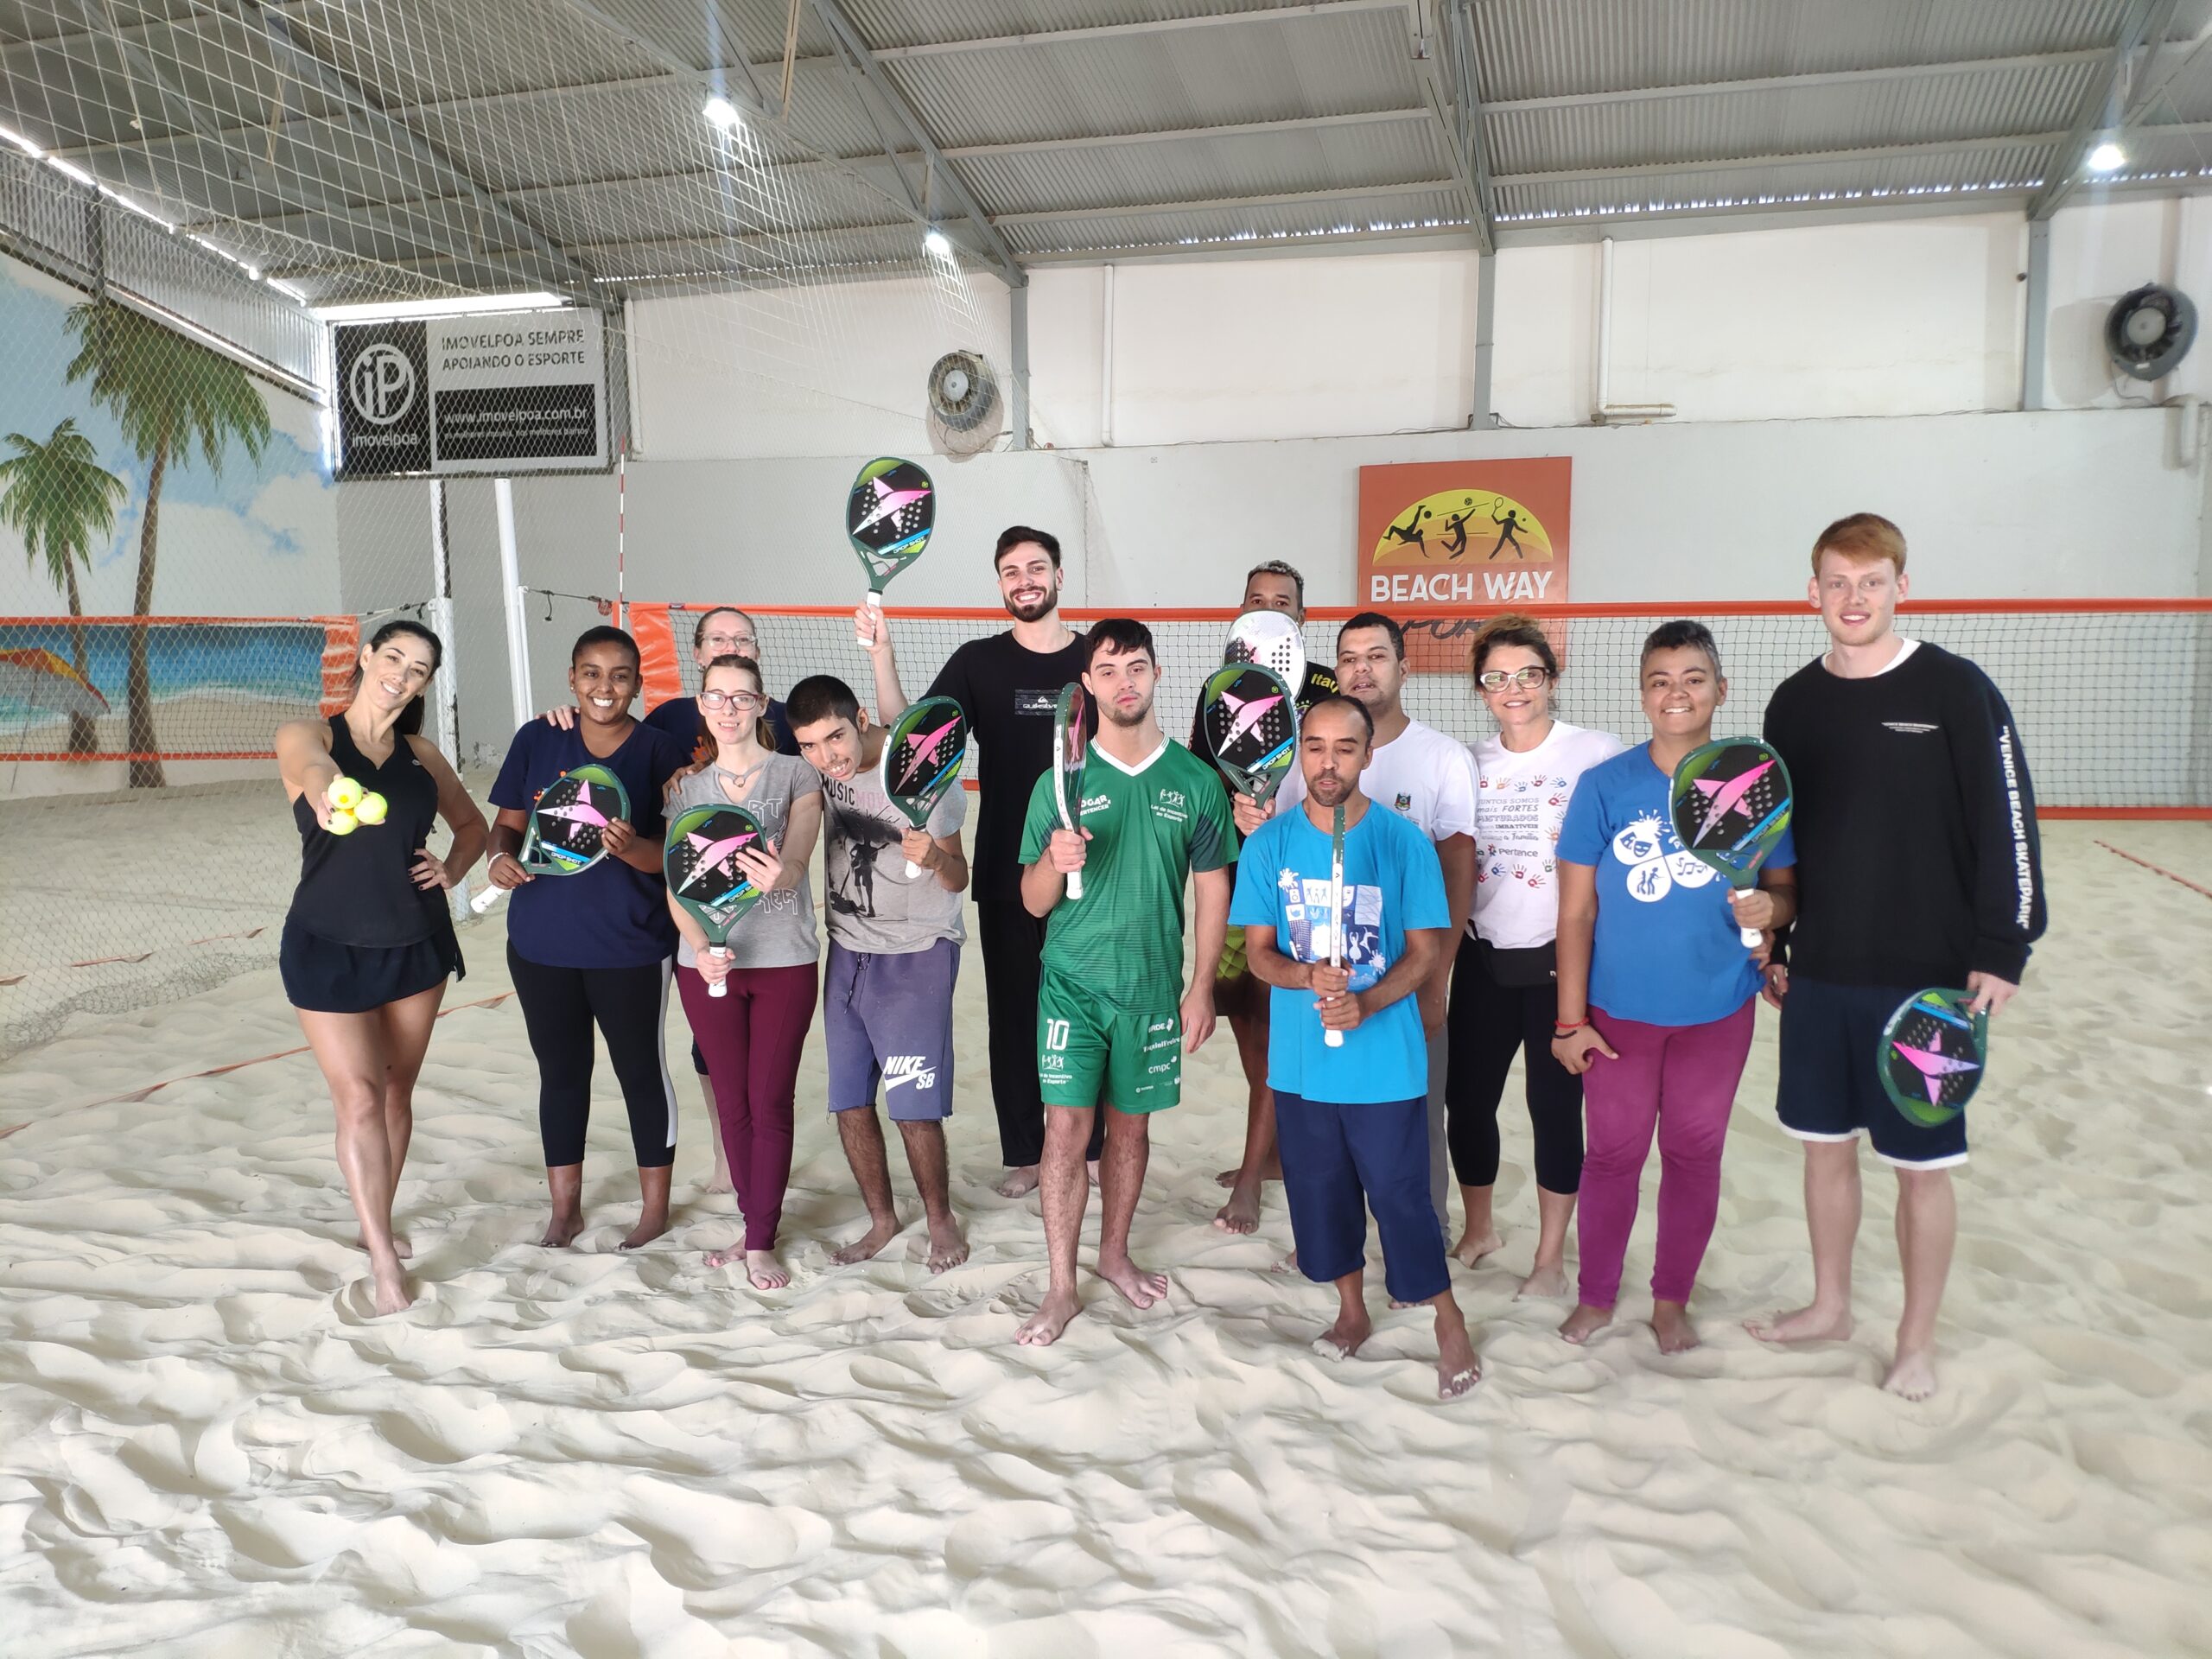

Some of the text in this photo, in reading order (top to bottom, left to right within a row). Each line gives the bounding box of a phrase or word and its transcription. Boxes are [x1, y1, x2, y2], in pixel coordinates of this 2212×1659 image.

[442, 329, 584, 351] IMOVELPOA SEMPRE
[442, 351, 585, 371] APOIANDO O ESPORTE
[444, 406, 588, 423] www.imovelpoa.com.br
[353, 431, 417, 448] imovelpoa
[1371, 571, 1553, 602] BEACH WAY
[1262, 757, 1277, 770] DROP
[1276, 747, 1291, 760] SHOT
[821, 773, 855, 805] MUSIC
[1080, 804, 1109, 816] ERTENCER
[2008, 790, 2026, 840] BEACH
[1046, 1018, 1070, 1051] 10
[883, 1056, 926, 1075] NIKE
[1148, 1063, 1171, 1074] cmpc
[916, 1072, 935, 1090] SB
